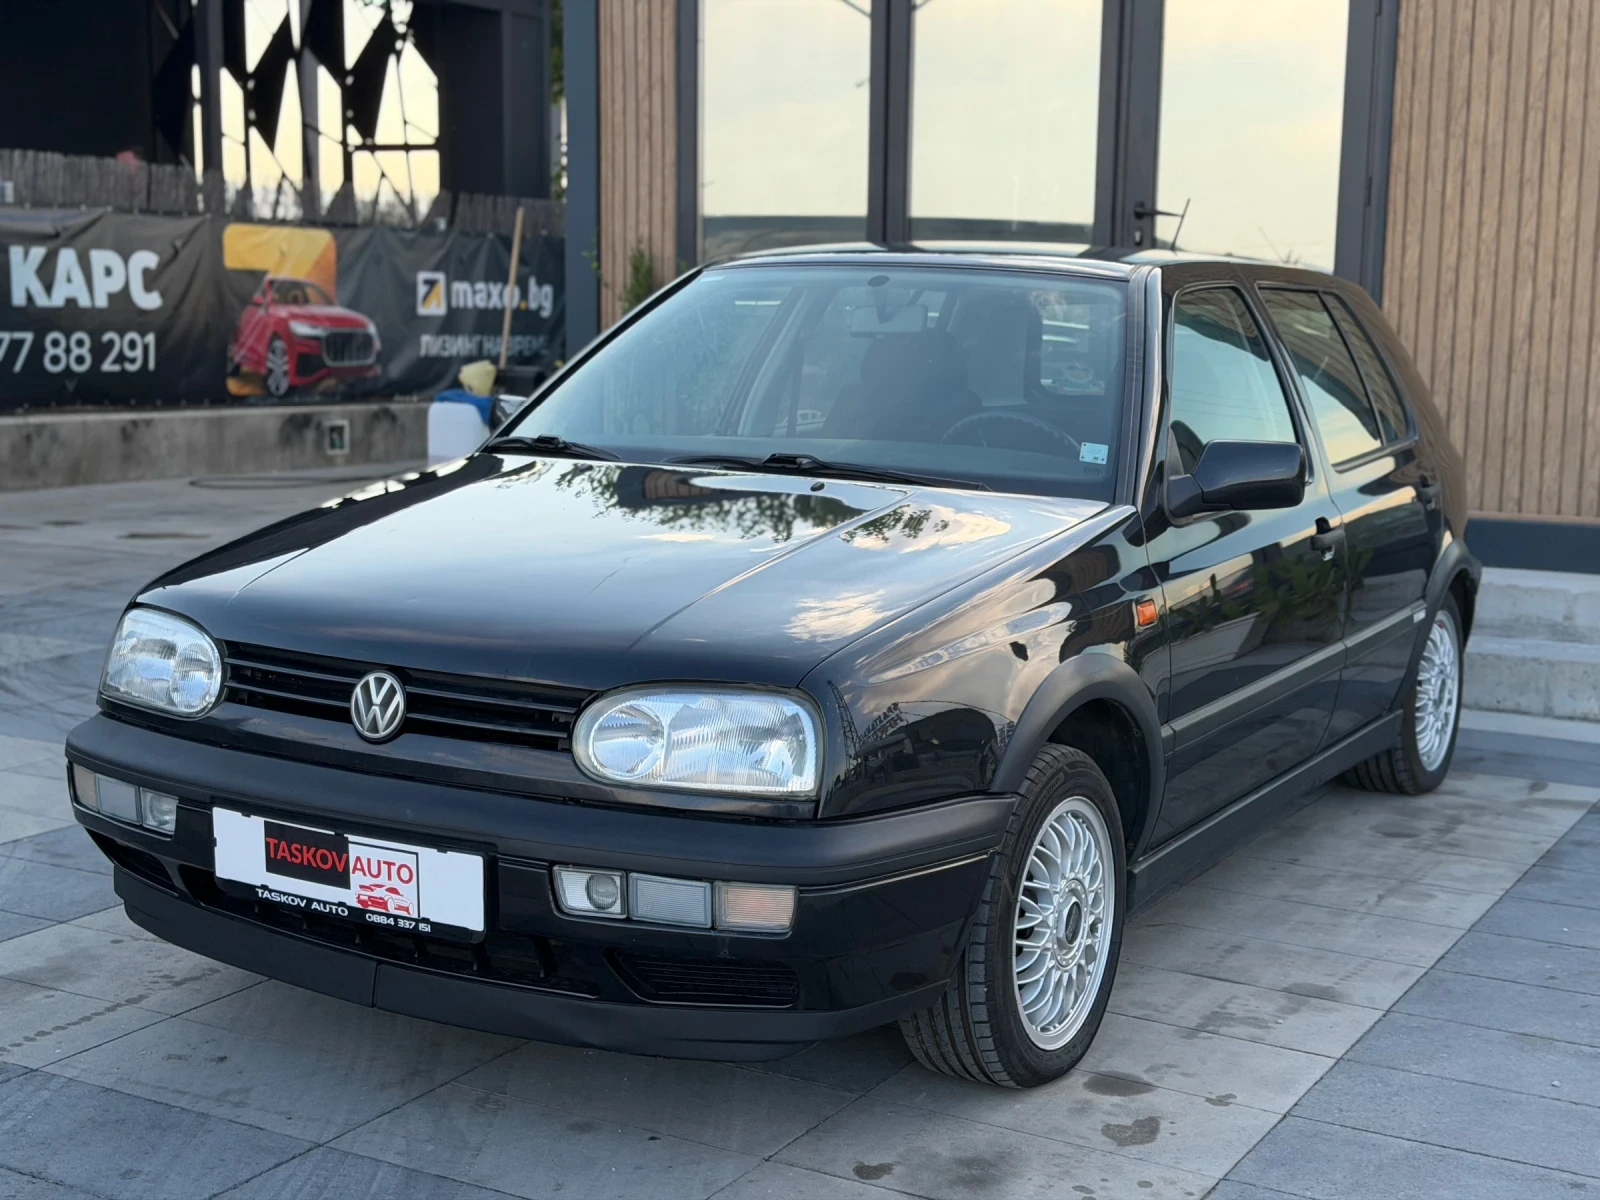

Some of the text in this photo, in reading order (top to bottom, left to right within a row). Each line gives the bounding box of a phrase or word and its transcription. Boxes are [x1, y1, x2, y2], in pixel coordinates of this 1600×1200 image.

[451, 275, 554, 319] maxo.bg
[43, 331, 93, 374] 88
[100, 331, 156, 373] 291
[265, 837, 414, 885] TASKOV AUTO
[255, 888, 349, 917] TASKOV AUTO
[365, 912, 431, 933] 0884 337 151
